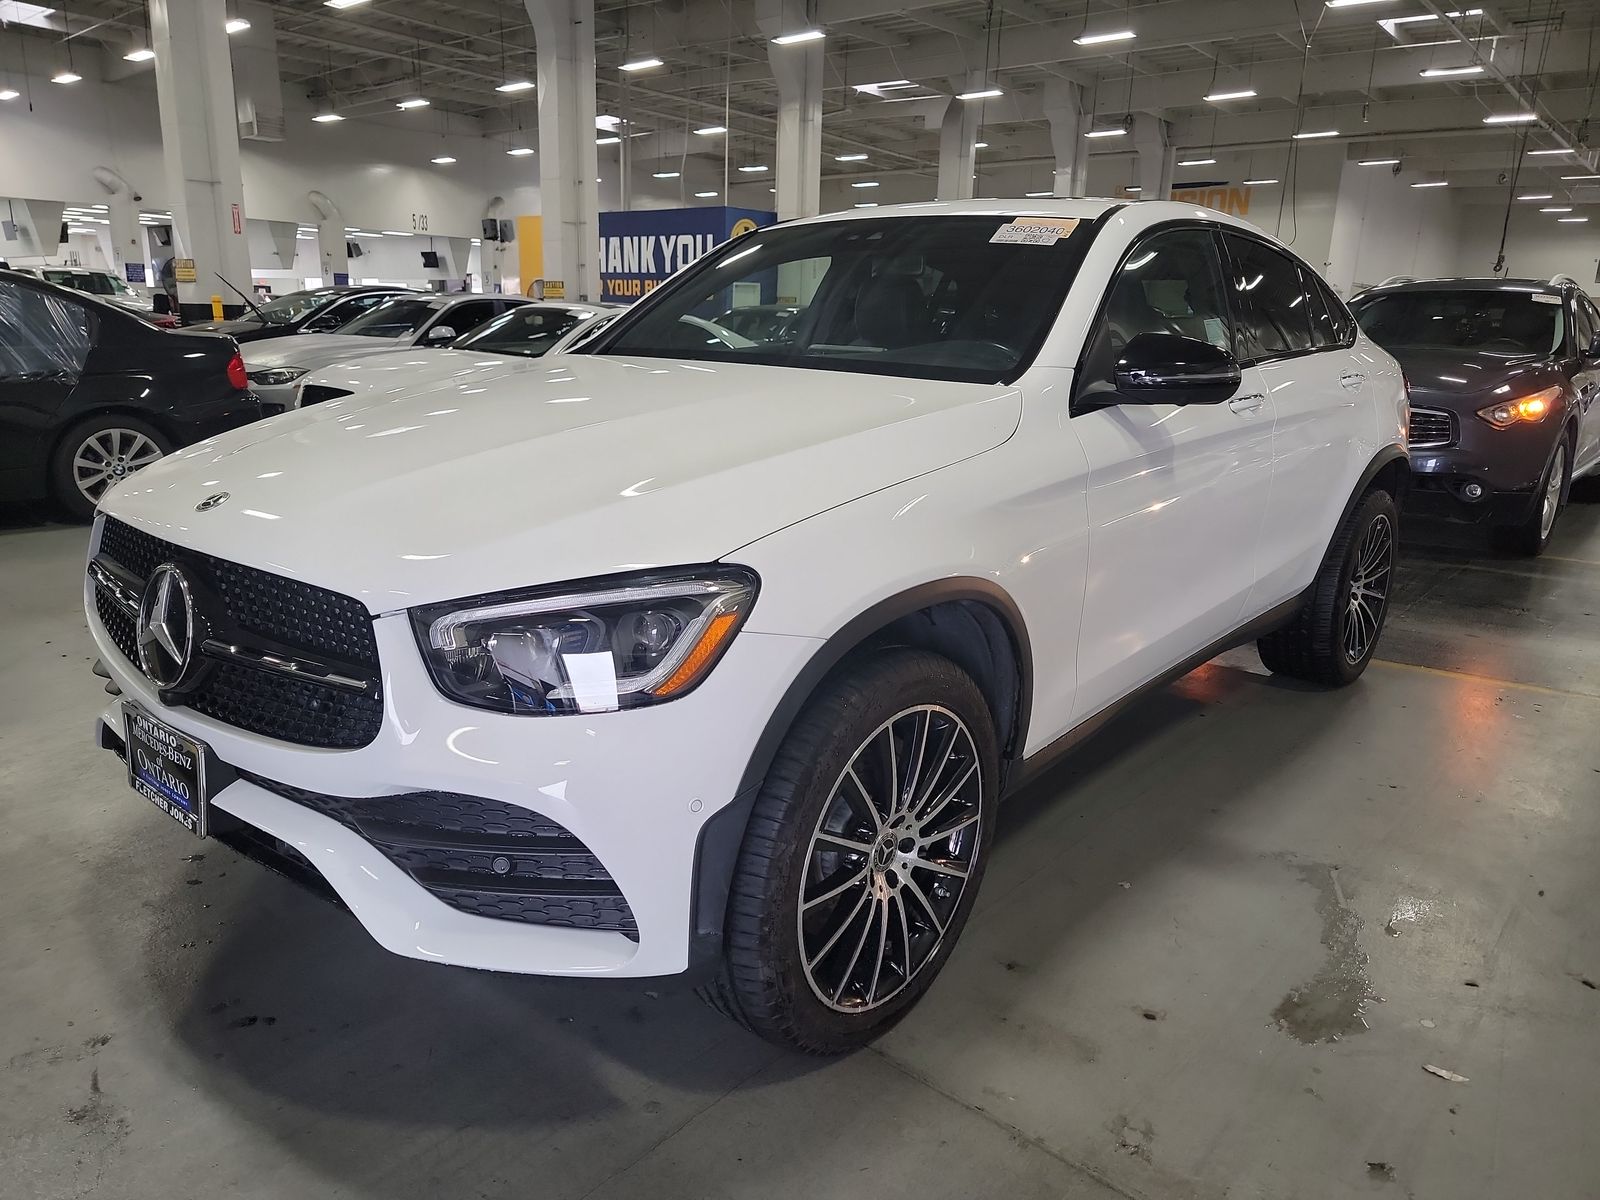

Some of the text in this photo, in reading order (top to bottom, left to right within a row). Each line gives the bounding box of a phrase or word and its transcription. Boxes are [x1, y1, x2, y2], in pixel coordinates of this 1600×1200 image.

[412, 213, 416, 230] 5
[1006, 225, 1065, 235] 3602040
[607, 279, 641, 296] YOUR
[136, 715, 177, 748] ONTARIO
[132, 721, 193, 770] MERCEDES-BENZ
[135, 780, 169, 813] FLETCHER
